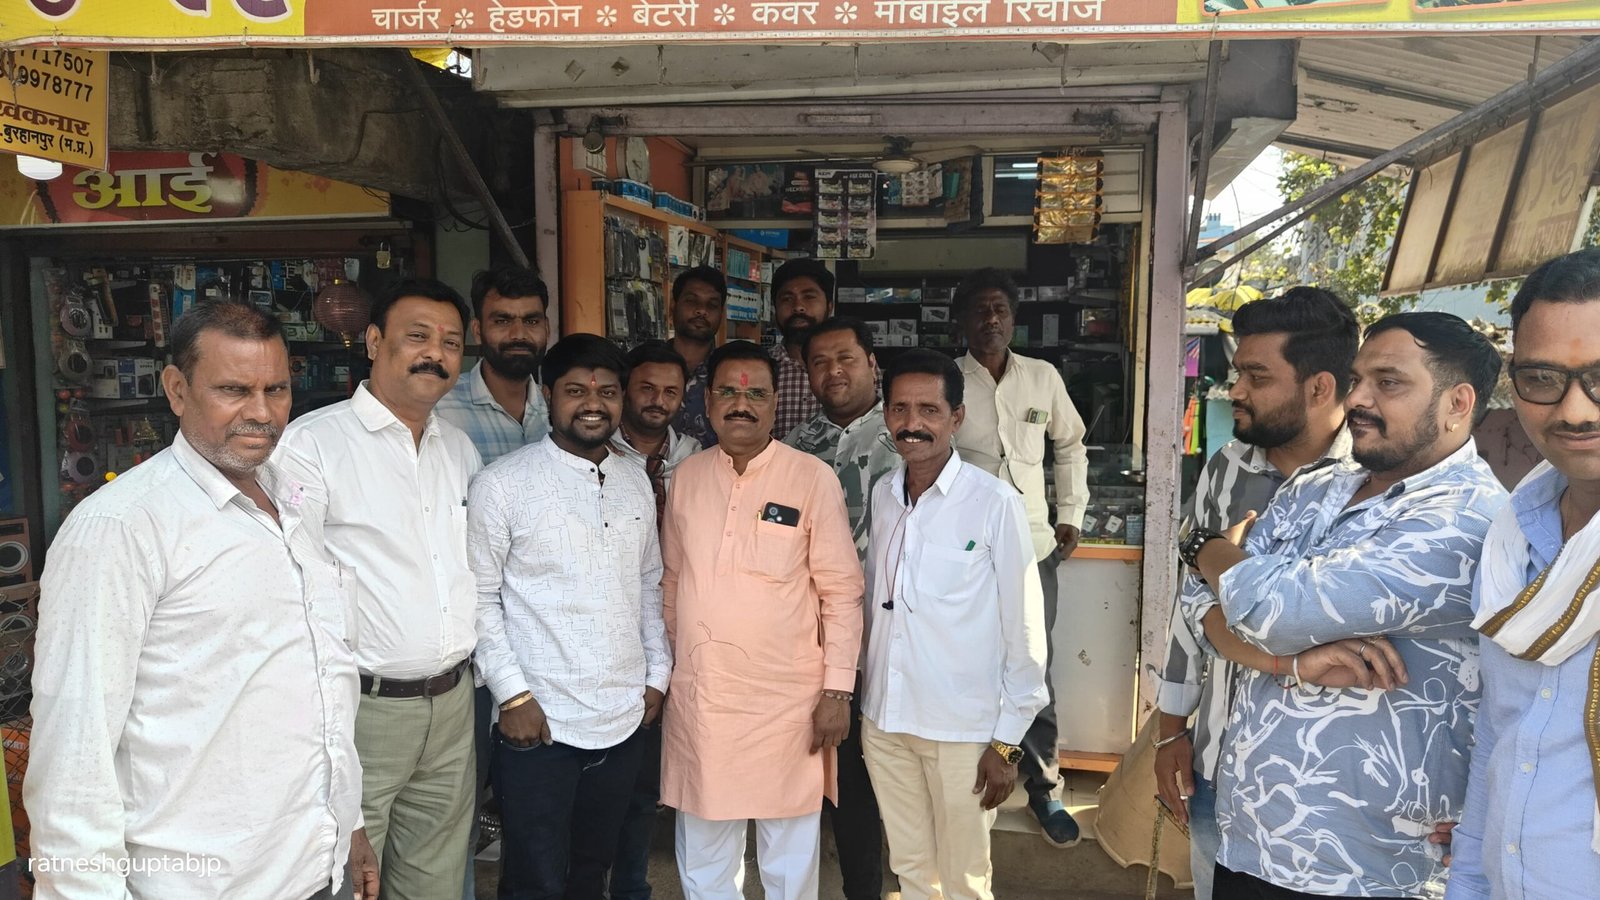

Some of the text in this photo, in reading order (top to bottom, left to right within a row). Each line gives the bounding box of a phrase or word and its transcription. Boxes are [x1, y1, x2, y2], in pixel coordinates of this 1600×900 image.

[371, 0, 442, 30] चार्जर
[487, 0, 583, 32] हेडफोन
[751, 2, 820, 25] कवर
[59, 134, 94, 159] (म.प्र.)
[72, 152, 218, 214] आई
